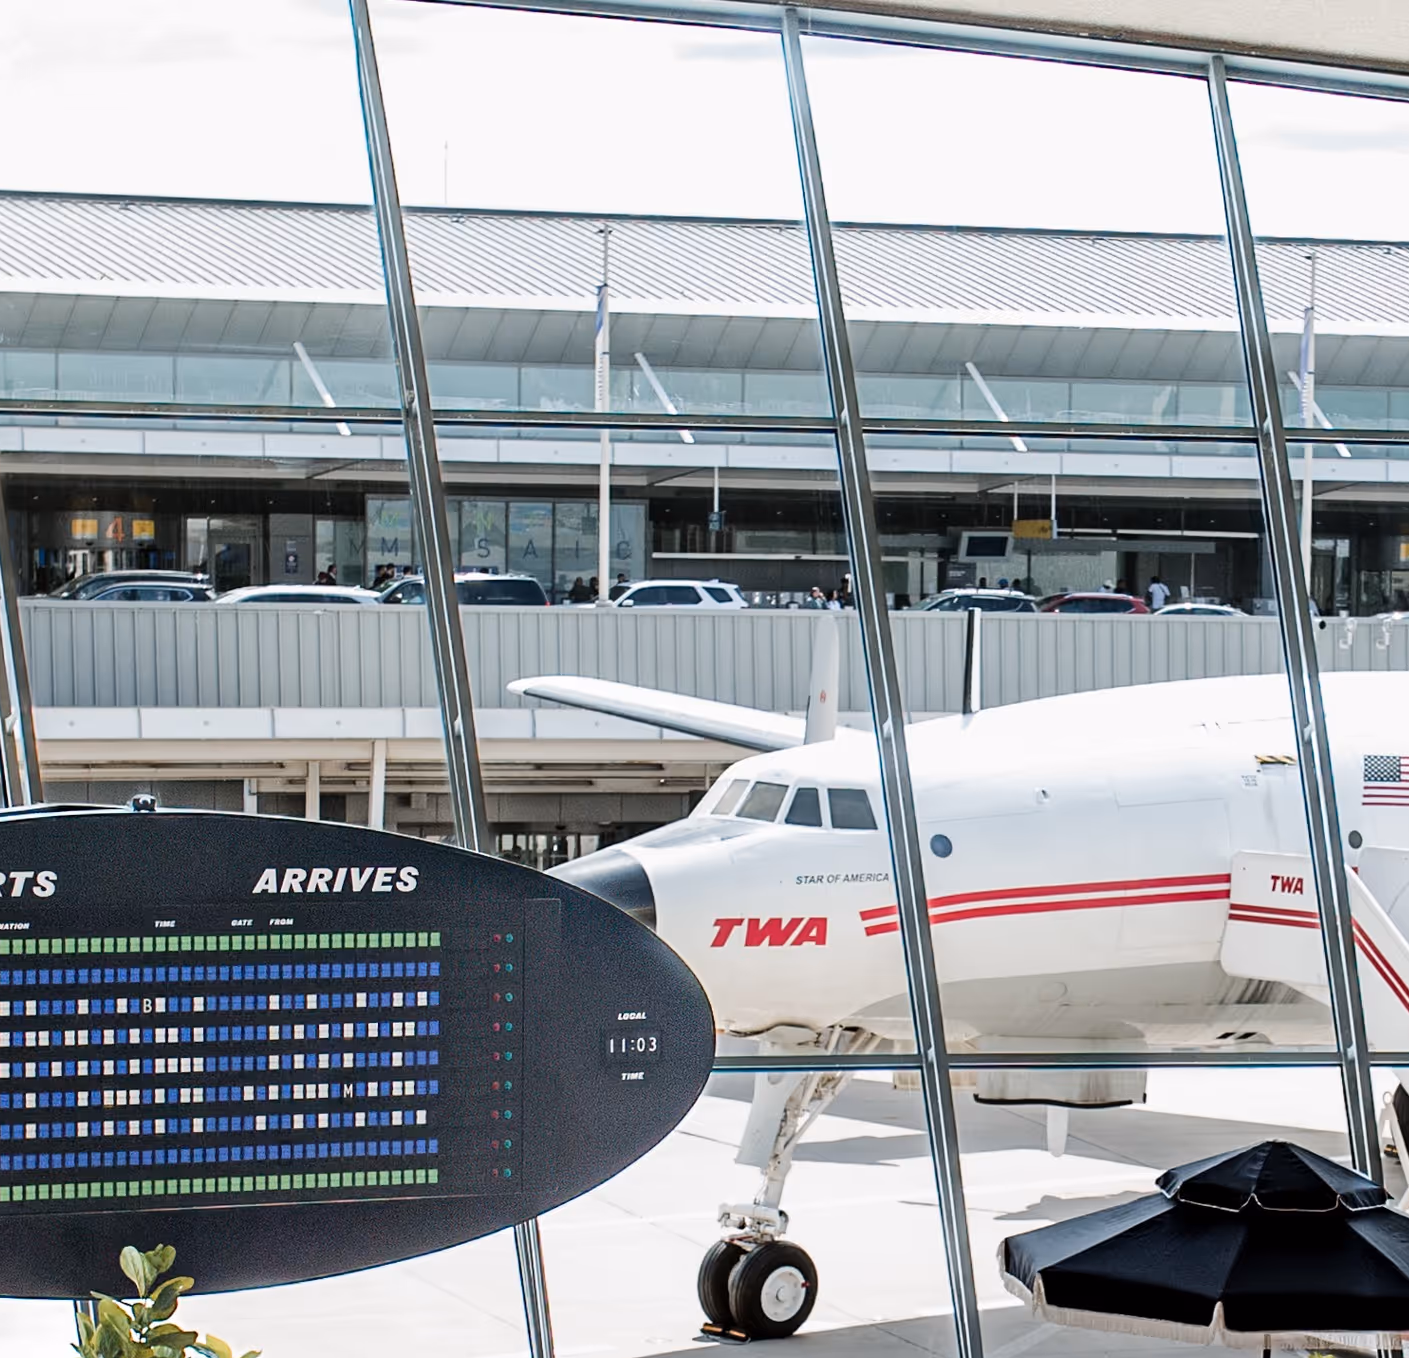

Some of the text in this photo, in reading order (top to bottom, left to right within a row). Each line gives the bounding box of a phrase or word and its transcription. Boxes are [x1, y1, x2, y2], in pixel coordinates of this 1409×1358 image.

[106, 516, 125, 542] 4
[252, 866, 419, 894] ARRIVES
[796, 873, 889, 885] STAR OF AMERICA
[1270, 875, 1304, 895] TWA
[154, 918, 294, 928] TIME GATE FROM
[710, 917, 828, 947] TWA
[143, 998, 153, 1013] B
[618, 1012, 647, 1020] LOCAL
[610, 1037, 657, 1053] 11:03
[621, 1072, 644, 1080] TIME
[343, 1084, 354, 1098] M
